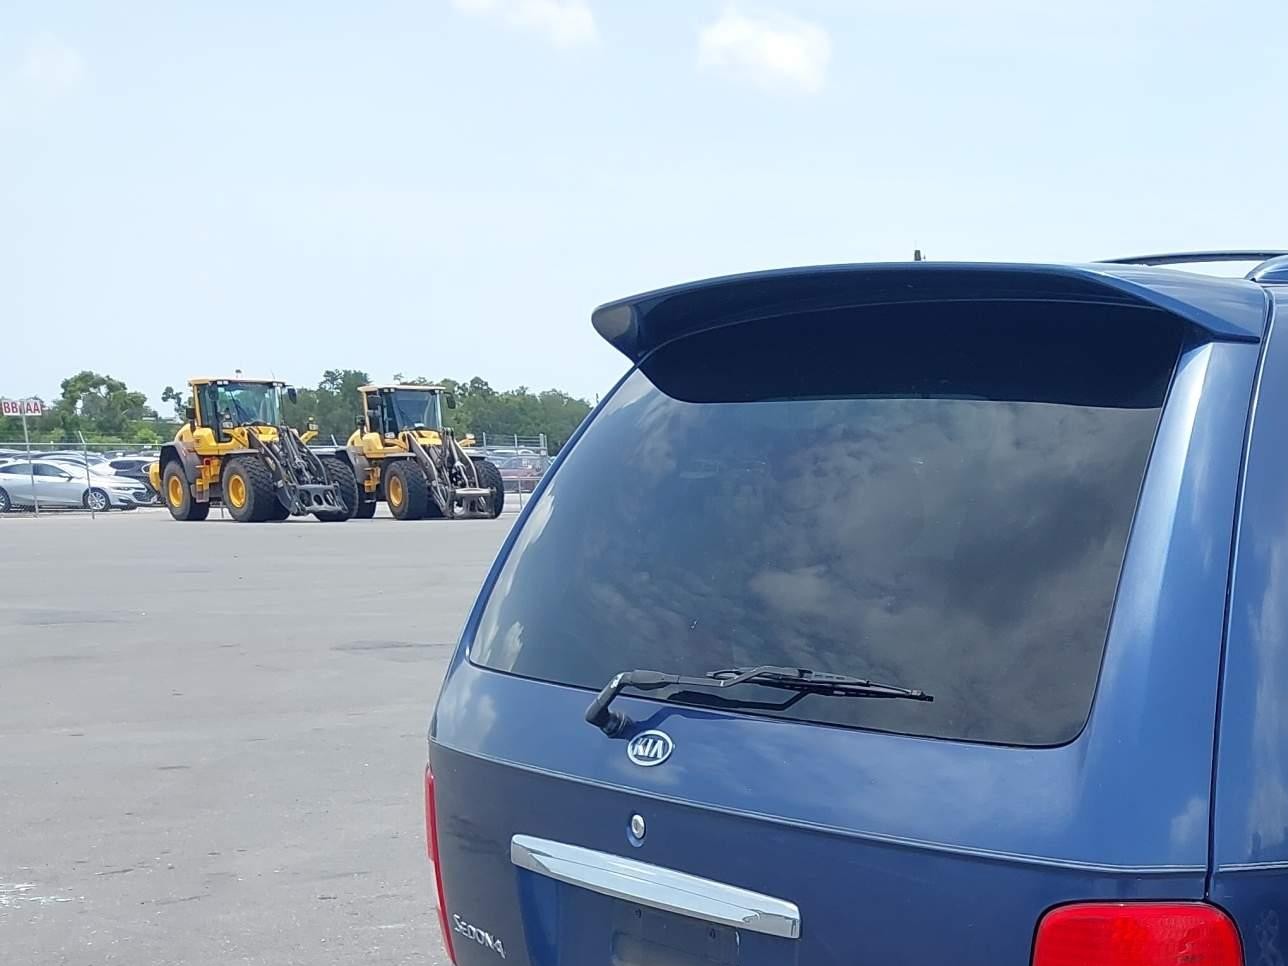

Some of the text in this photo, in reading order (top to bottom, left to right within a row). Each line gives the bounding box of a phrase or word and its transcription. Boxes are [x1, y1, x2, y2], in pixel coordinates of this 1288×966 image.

[3, 401, 41, 414] BB AA
[633, 737, 664, 758] KIA
